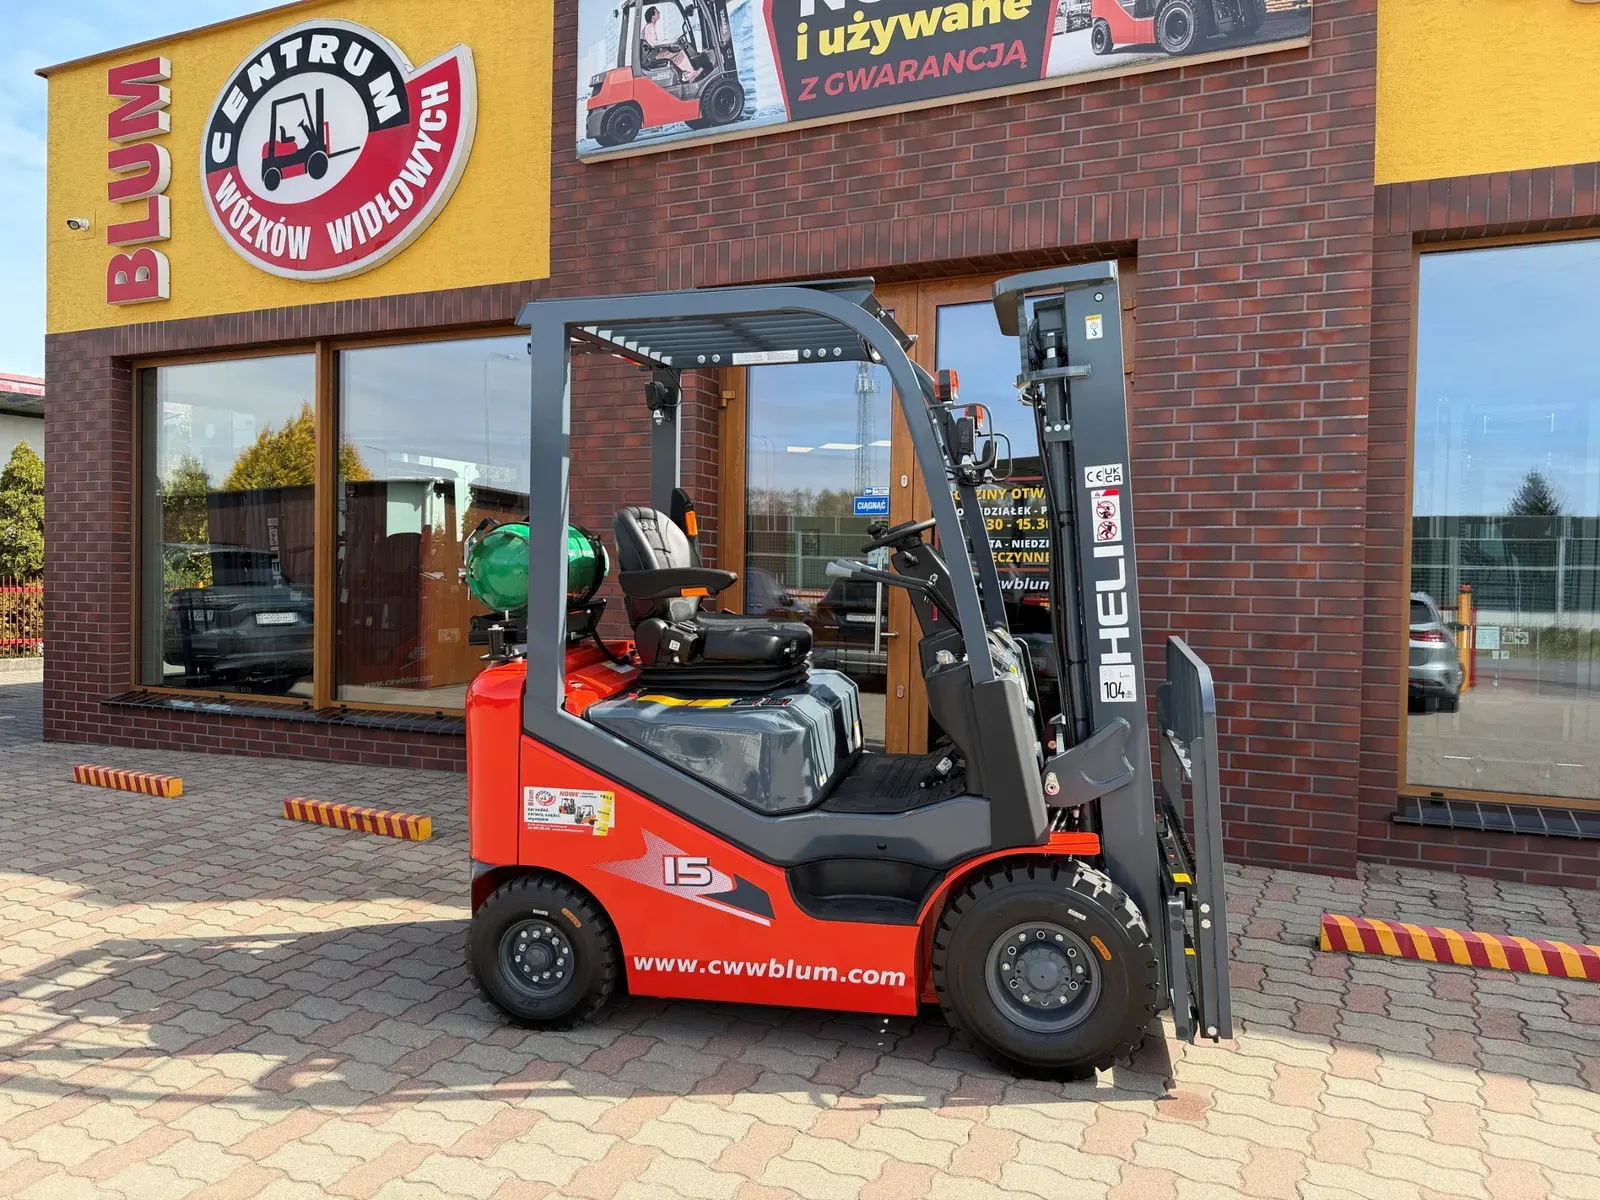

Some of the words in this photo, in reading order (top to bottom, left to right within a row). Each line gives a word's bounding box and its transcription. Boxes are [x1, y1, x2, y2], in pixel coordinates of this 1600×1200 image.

[797, 22, 808, 61] i
[818, 0, 1031, 56] używane
[798, 76, 819, 101] Z
[824, 39, 1028, 96] GWARANCJĄ
[211, 34, 402, 163] CENTRUM
[106, 57, 171, 305] BLUM
[214, 172, 311, 260] WÓZKÓW
[326, 80, 449, 255] WIDŁOWYCH
[857, 499, 886, 511] CIĄGNĄĆ
[1011, 488, 1046, 500] OTW
[1012, 539, 1049, 548] NIEDZI
[1093, 545, 1132, 664] HELI
[1103, 681, 1125, 699] 104
[663, 855, 712, 887] 15
[633, 955, 906, 987] www.cwwblum.com
